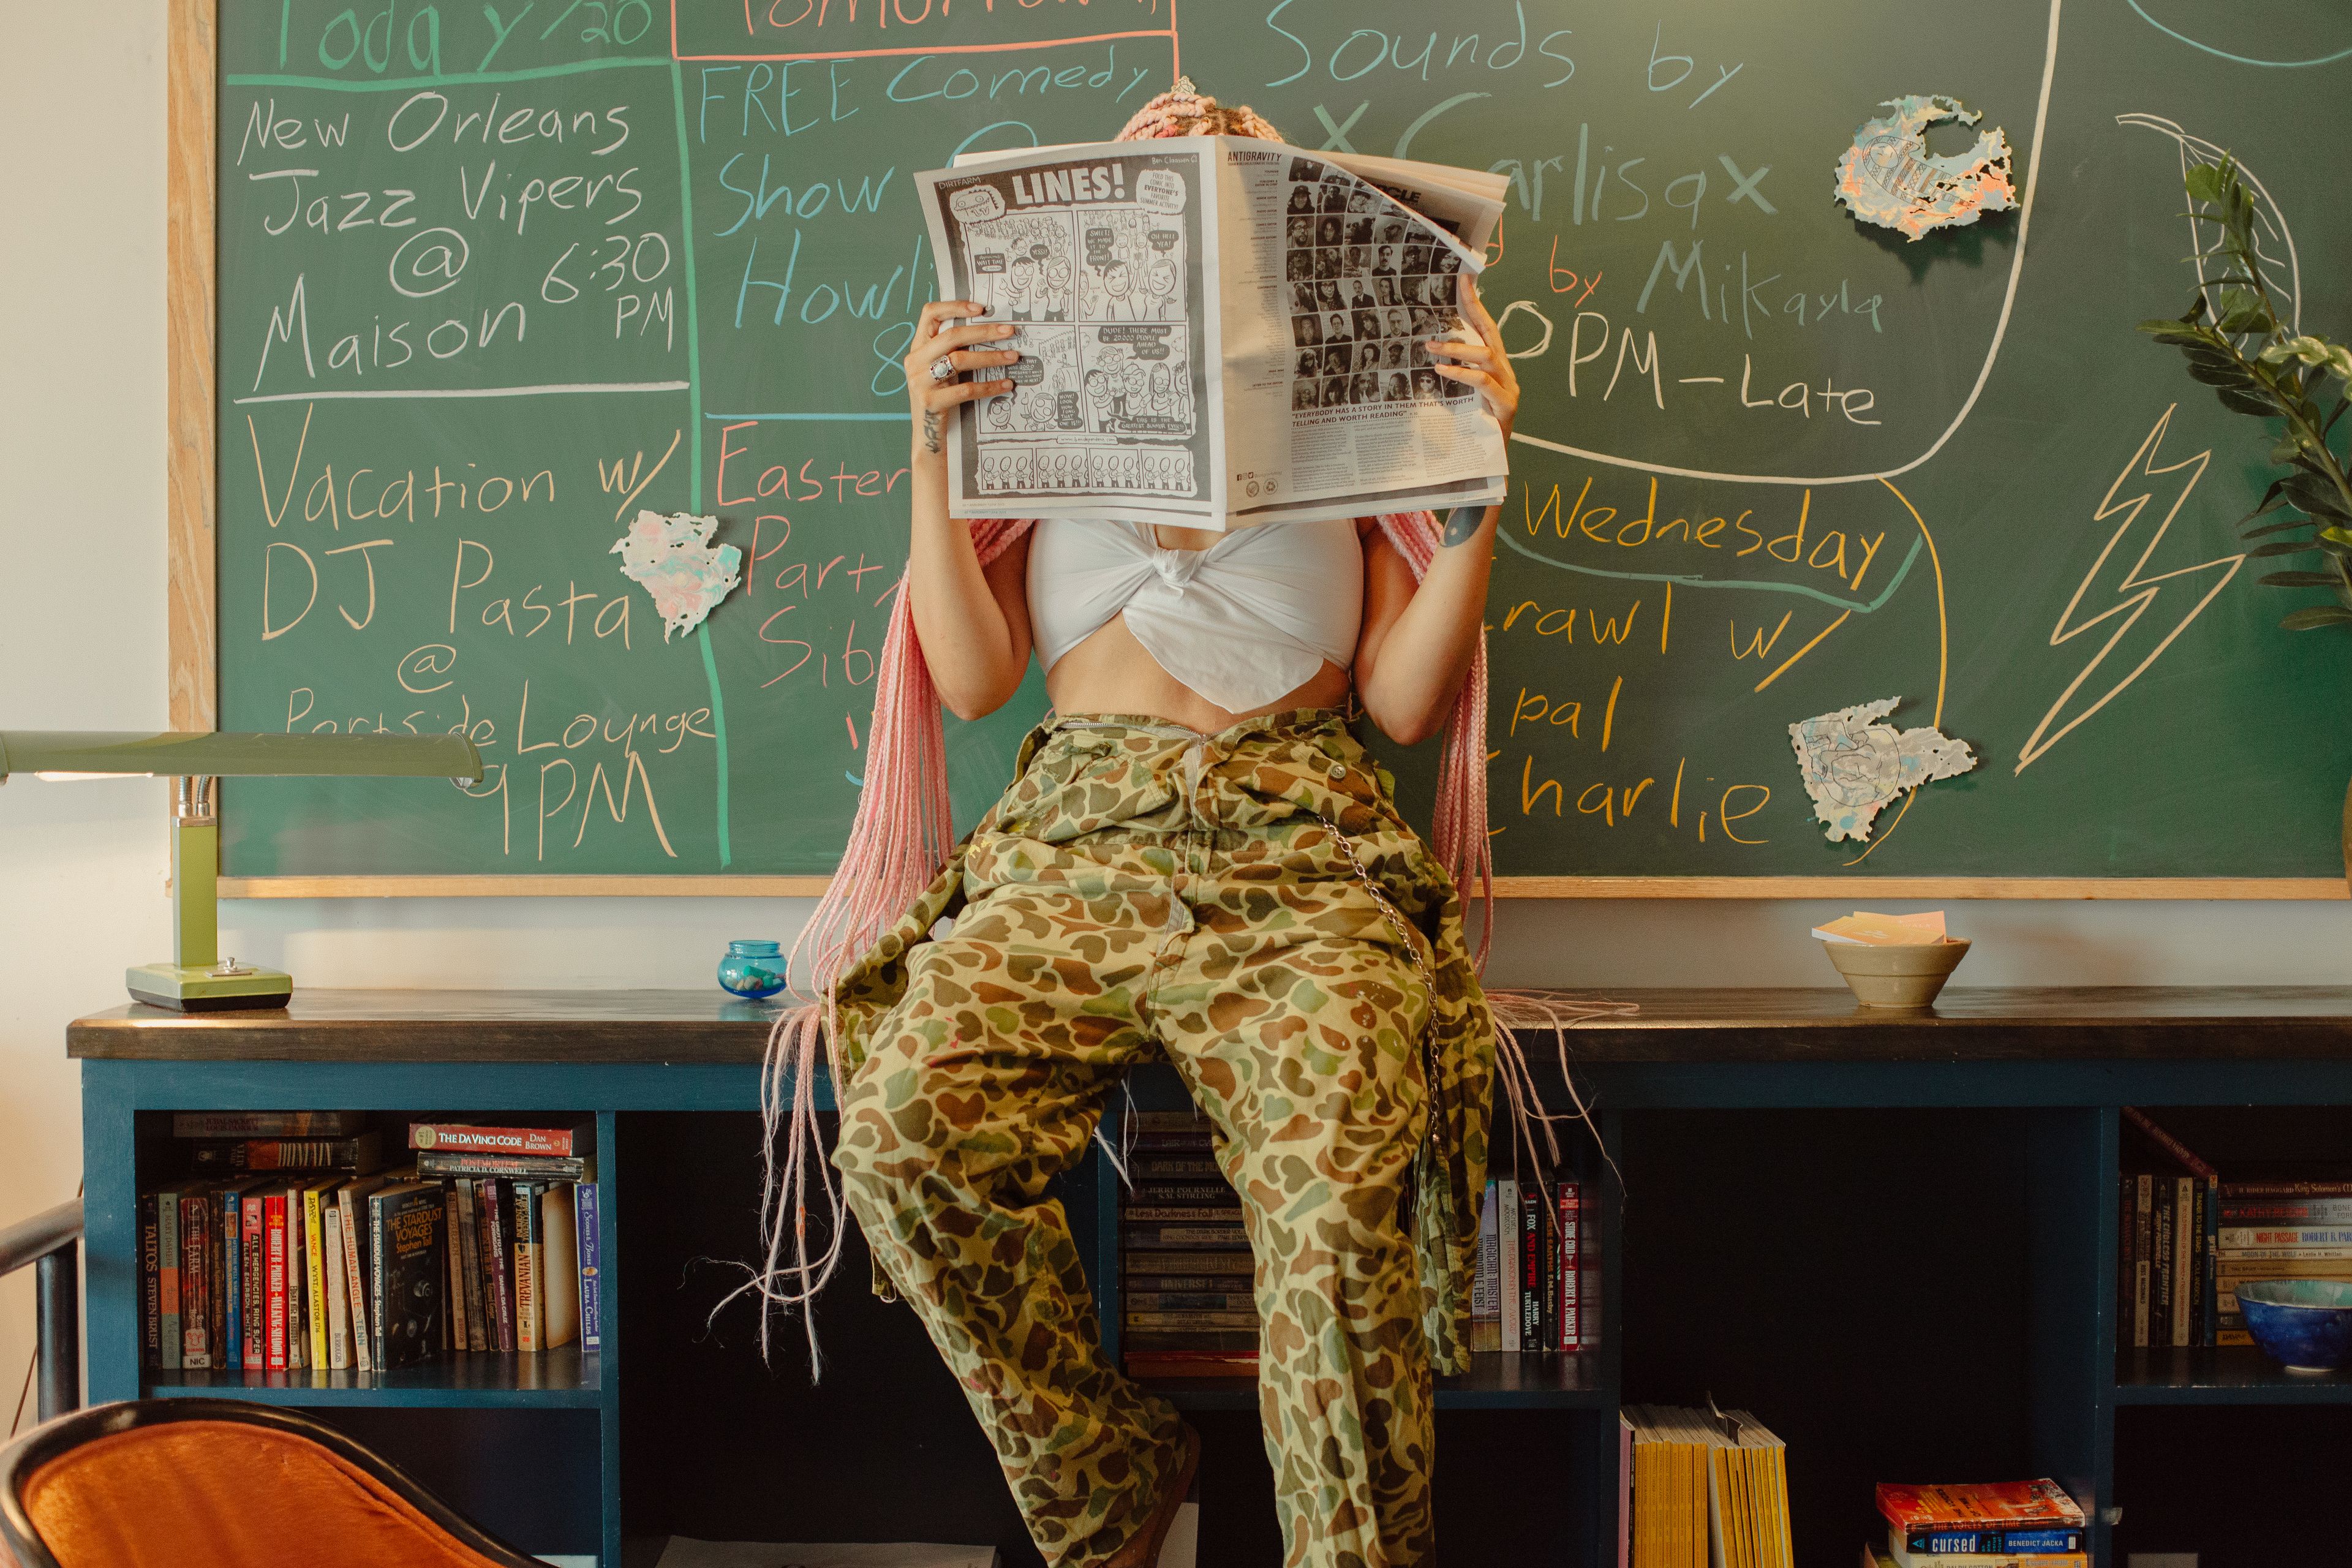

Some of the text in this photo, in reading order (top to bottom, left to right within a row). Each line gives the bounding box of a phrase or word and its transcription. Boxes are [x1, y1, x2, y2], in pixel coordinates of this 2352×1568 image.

[1266, 0, 1743, 109] Sounds by
[700, 45, 1148, 143] FREE Comedy
[237, 91, 629, 165] New Orleans
[1152, 156, 1163, 165] Ben
[1227, 151, 1283, 162] ANTIGRAVITY
[249, 160, 641, 235] Jazz Vipers
[713, 153, 894, 236] Show
[938, 175, 981, 189] DIRTFARM
[1011, 163, 1126, 206] LINES!
[1144, 184, 1179, 197] EVERYONE'S
[1151, 192, 1170, 202] FAVORITE
[1140, 197, 1158, 206] SUMMER
[390, 228, 669, 303] @ 6:30
[735, 228, 935, 328] Howli
[1550, 235, 1602, 308] by
[1637, 239, 1882, 341] Mikayla
[254, 274, 525, 391] Maison
[616, 287, 673, 352] PM
[1292, 418, 1321, 428] TELLING
[1339, 413, 1368, 423] WORTH
[1358, 404, 1382, 413] STORY
[1446, 397, 1474, 407] WORTH
[248, 403, 680, 530] Vacation w/
[717, 421, 911, 506] Easter
[1525, 477, 1885, 591] Wednesday
[263, 538, 631, 650] DJ Pasta
[1484, 582, 1850, 693] rawl w/
[398, 644, 456, 693] @
[518, 680, 717, 758] Lounge
[1510, 676, 1623, 752] pal
[1487, 748, 1771, 843] harlie
[438, 1132, 458, 1144] THE
[497, 1135, 522, 1147] CODE
[524, 1140, 552, 1150] BROWN
[529, 1133, 546, 1142] DAN
[395, 1224, 433, 1242] VOYAGES
[402, 1207, 442, 1227] STARDUST
[1526, 1215, 1536, 1230] FOX
[270, 1229, 282, 1257] ROBERT
[1527, 1232, 1536, 1252] AND
[1565, 1222, 1576, 1254] STONE COLD
[2256, 1232, 2328, 1243] NIGHT PASSAGE ROBERT
[145, 1223, 158, 1349] TALTOS STEVEN BRUST
[271, 1265, 282, 1292] PARKER
[344, 1213, 365, 1346] THE HUMAN ANGLE TENN
[518, 1254, 532, 1308] TREVANIAN
[1488, 1278, 1498, 1311] MASTER
[271, 1297, 282, 1327] WALKING
[1474, 1287, 1485, 1308] FEIST
[1565, 1270, 1576, 1335] ROBERT PARKER
[252, 1329, 261, 1354] SUPER
[271, 1327, 283, 1356] SHADOW
[189, 1357, 205, 1366] NIC
[1932, 1534, 1976, 1553] cursed
